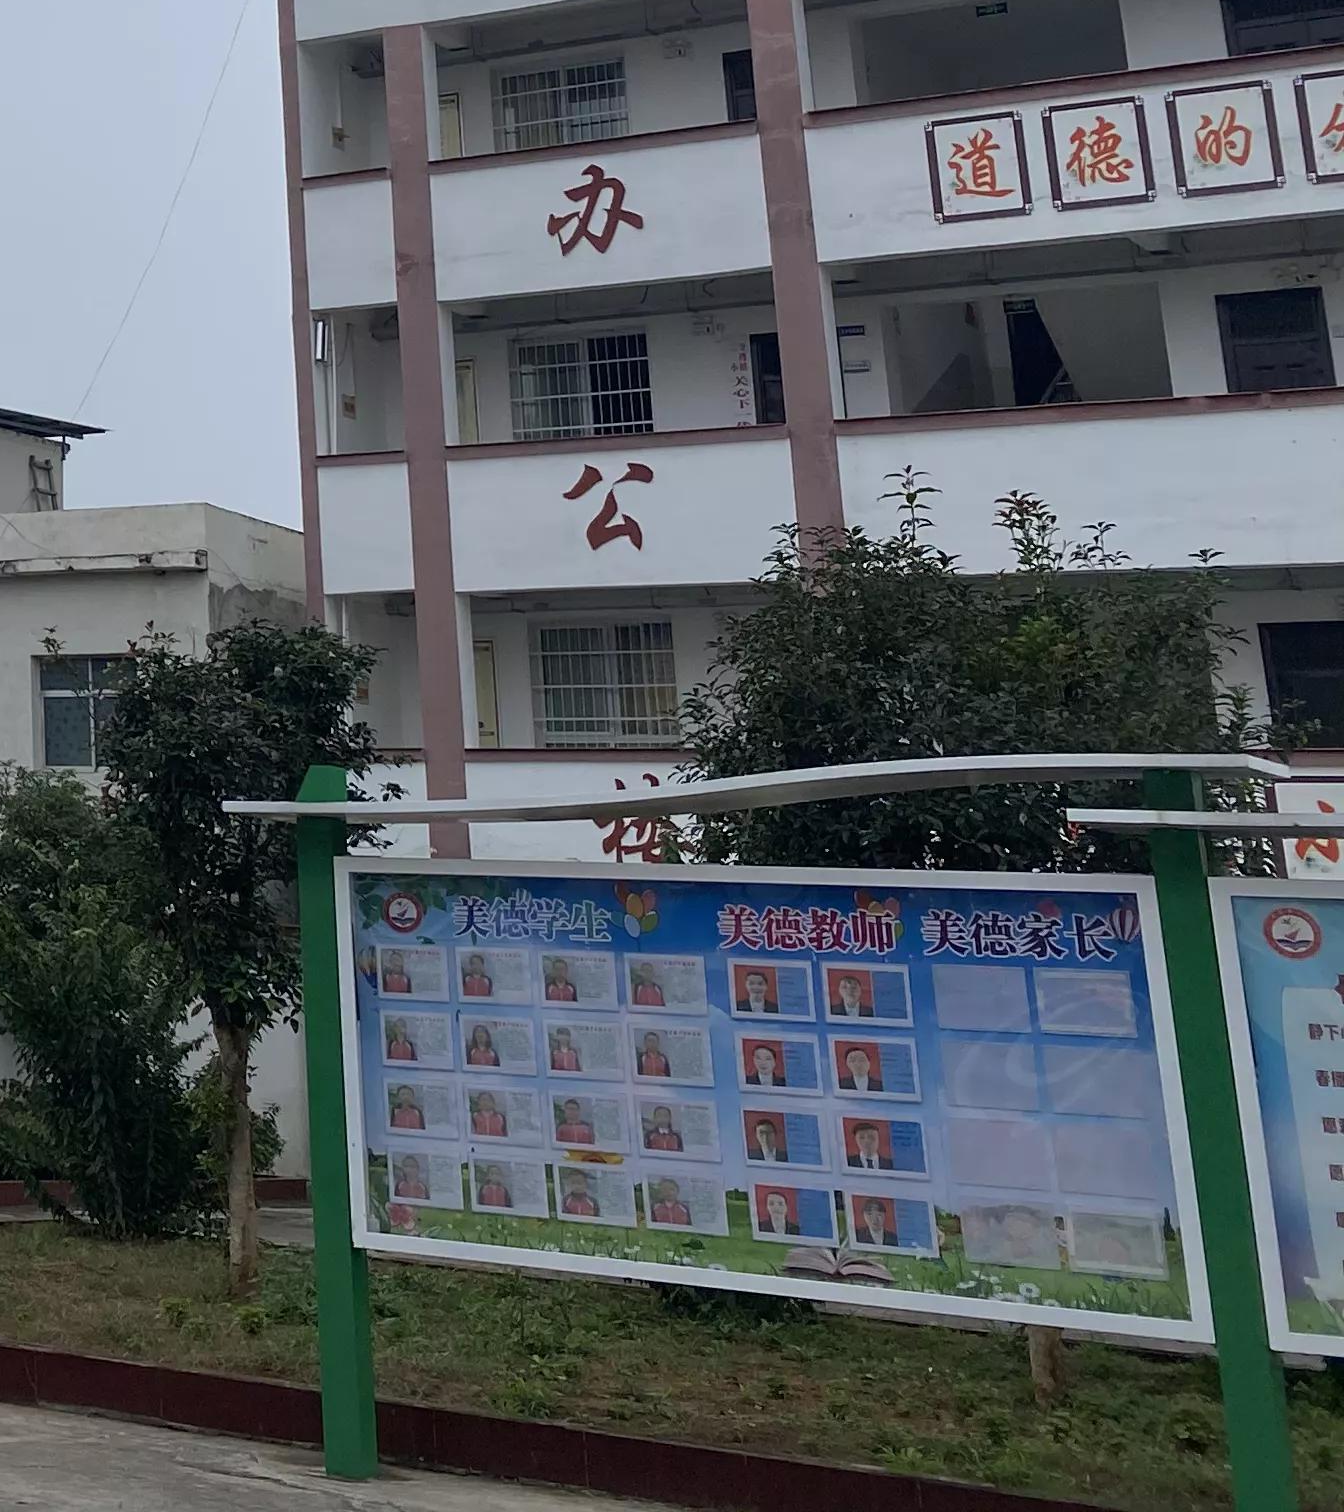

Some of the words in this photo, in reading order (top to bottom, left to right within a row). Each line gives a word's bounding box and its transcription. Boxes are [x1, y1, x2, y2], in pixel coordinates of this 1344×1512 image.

[949, 100, 1344, 197] 道德的
[453, 895, 612, 944] 美德学生
[717, 904, 900, 957] 美德教师
[920, 909, 1118, 963] 美德家长
